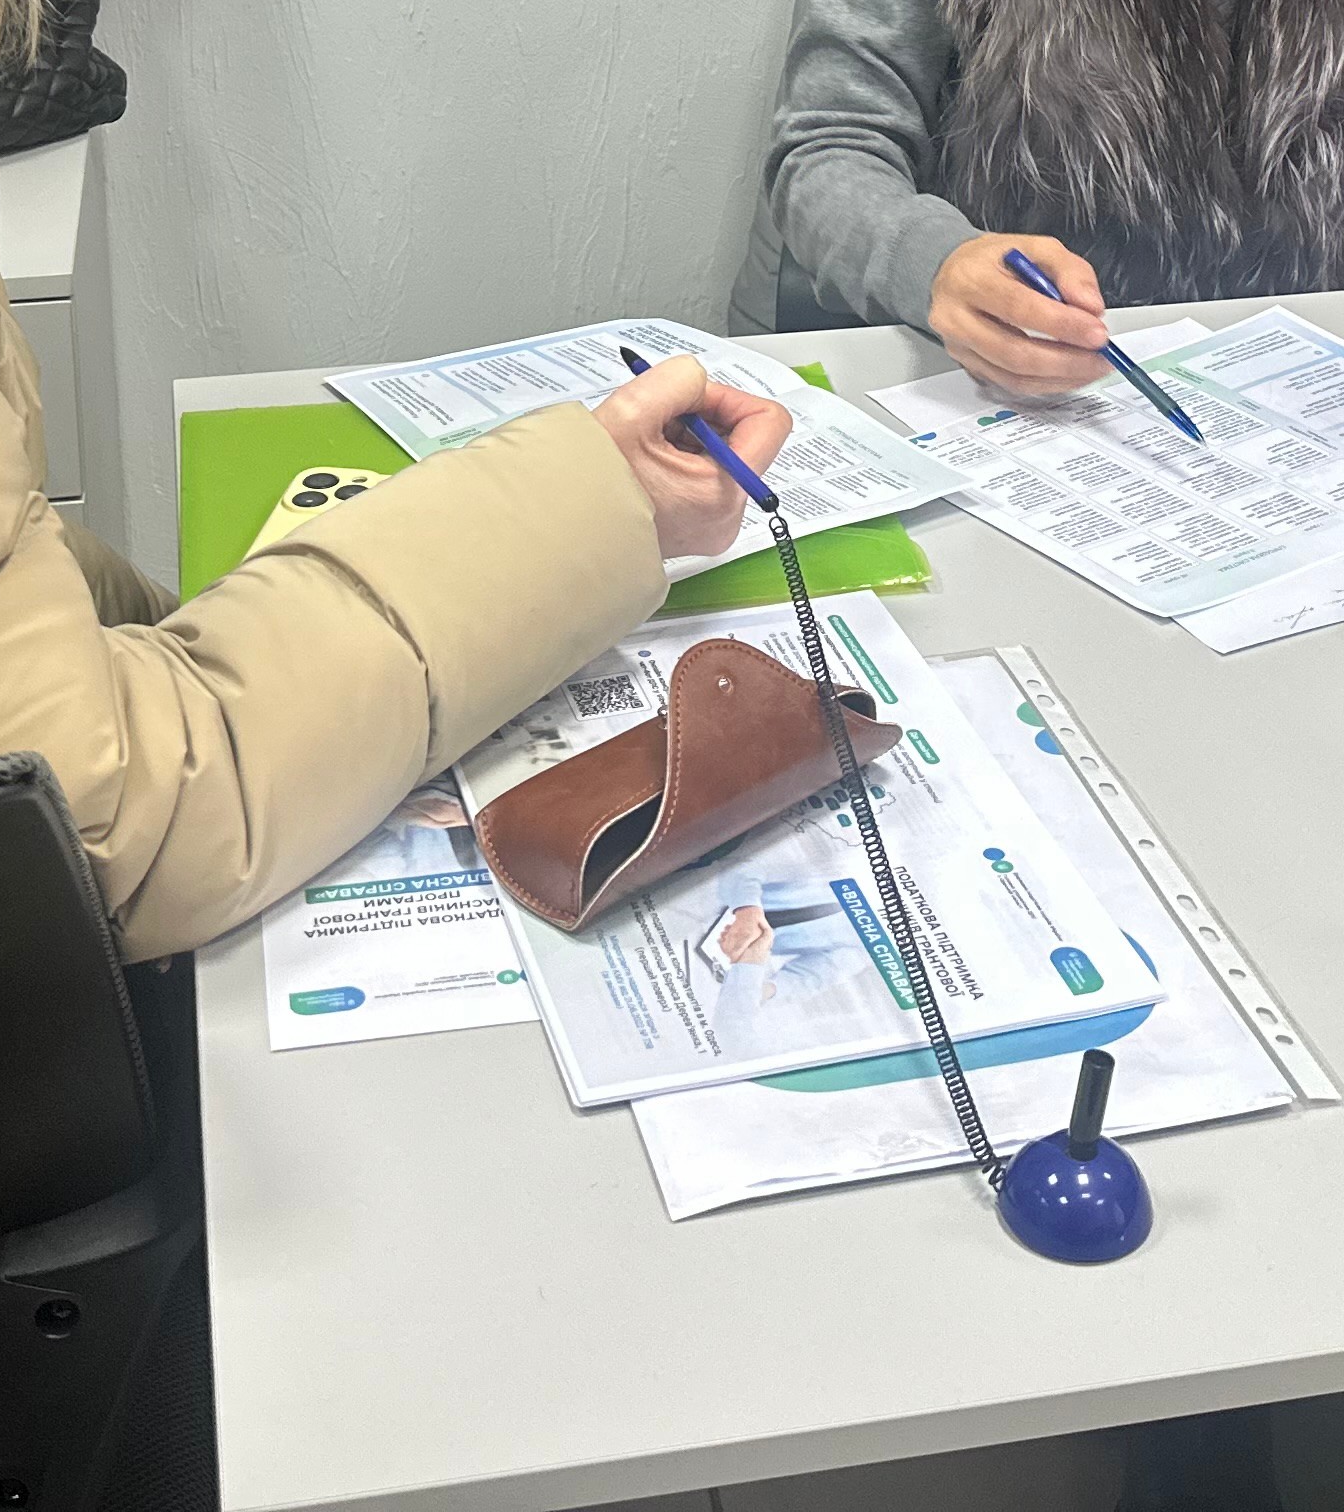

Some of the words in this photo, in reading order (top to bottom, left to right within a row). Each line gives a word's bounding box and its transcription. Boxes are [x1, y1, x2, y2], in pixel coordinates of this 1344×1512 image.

[312, 907, 411, 926] ГРАНТОВОЇ
[314, 881, 406, 899] СПРАВА»
[362, 890, 461, 907] ПРОГРАМИ
[303, 918, 412, 938] ПІДТРИМКА
[837, 883, 881, 939] «ВЛАСНА
[871, 943, 919, 1004] СПРАВА»
[891, 865, 942, 930] ПОДАТКОВА
[931, 931, 985, 1000] ПІДТРИМКА
[633, 946, 657, 980] (перший
[649, 980, 672, 1013] поверх)
[648, 912, 677, 956] податкових
[702, 1029, 724, 1056] Одеса,
[649, 945, 668, 971] площа
[660, 972, 682, 1001] Бориса
[673, 1001, 704, 1049] Дерев'янка,
[913, 935, 965, 997] ГРАНТОВОЇ
